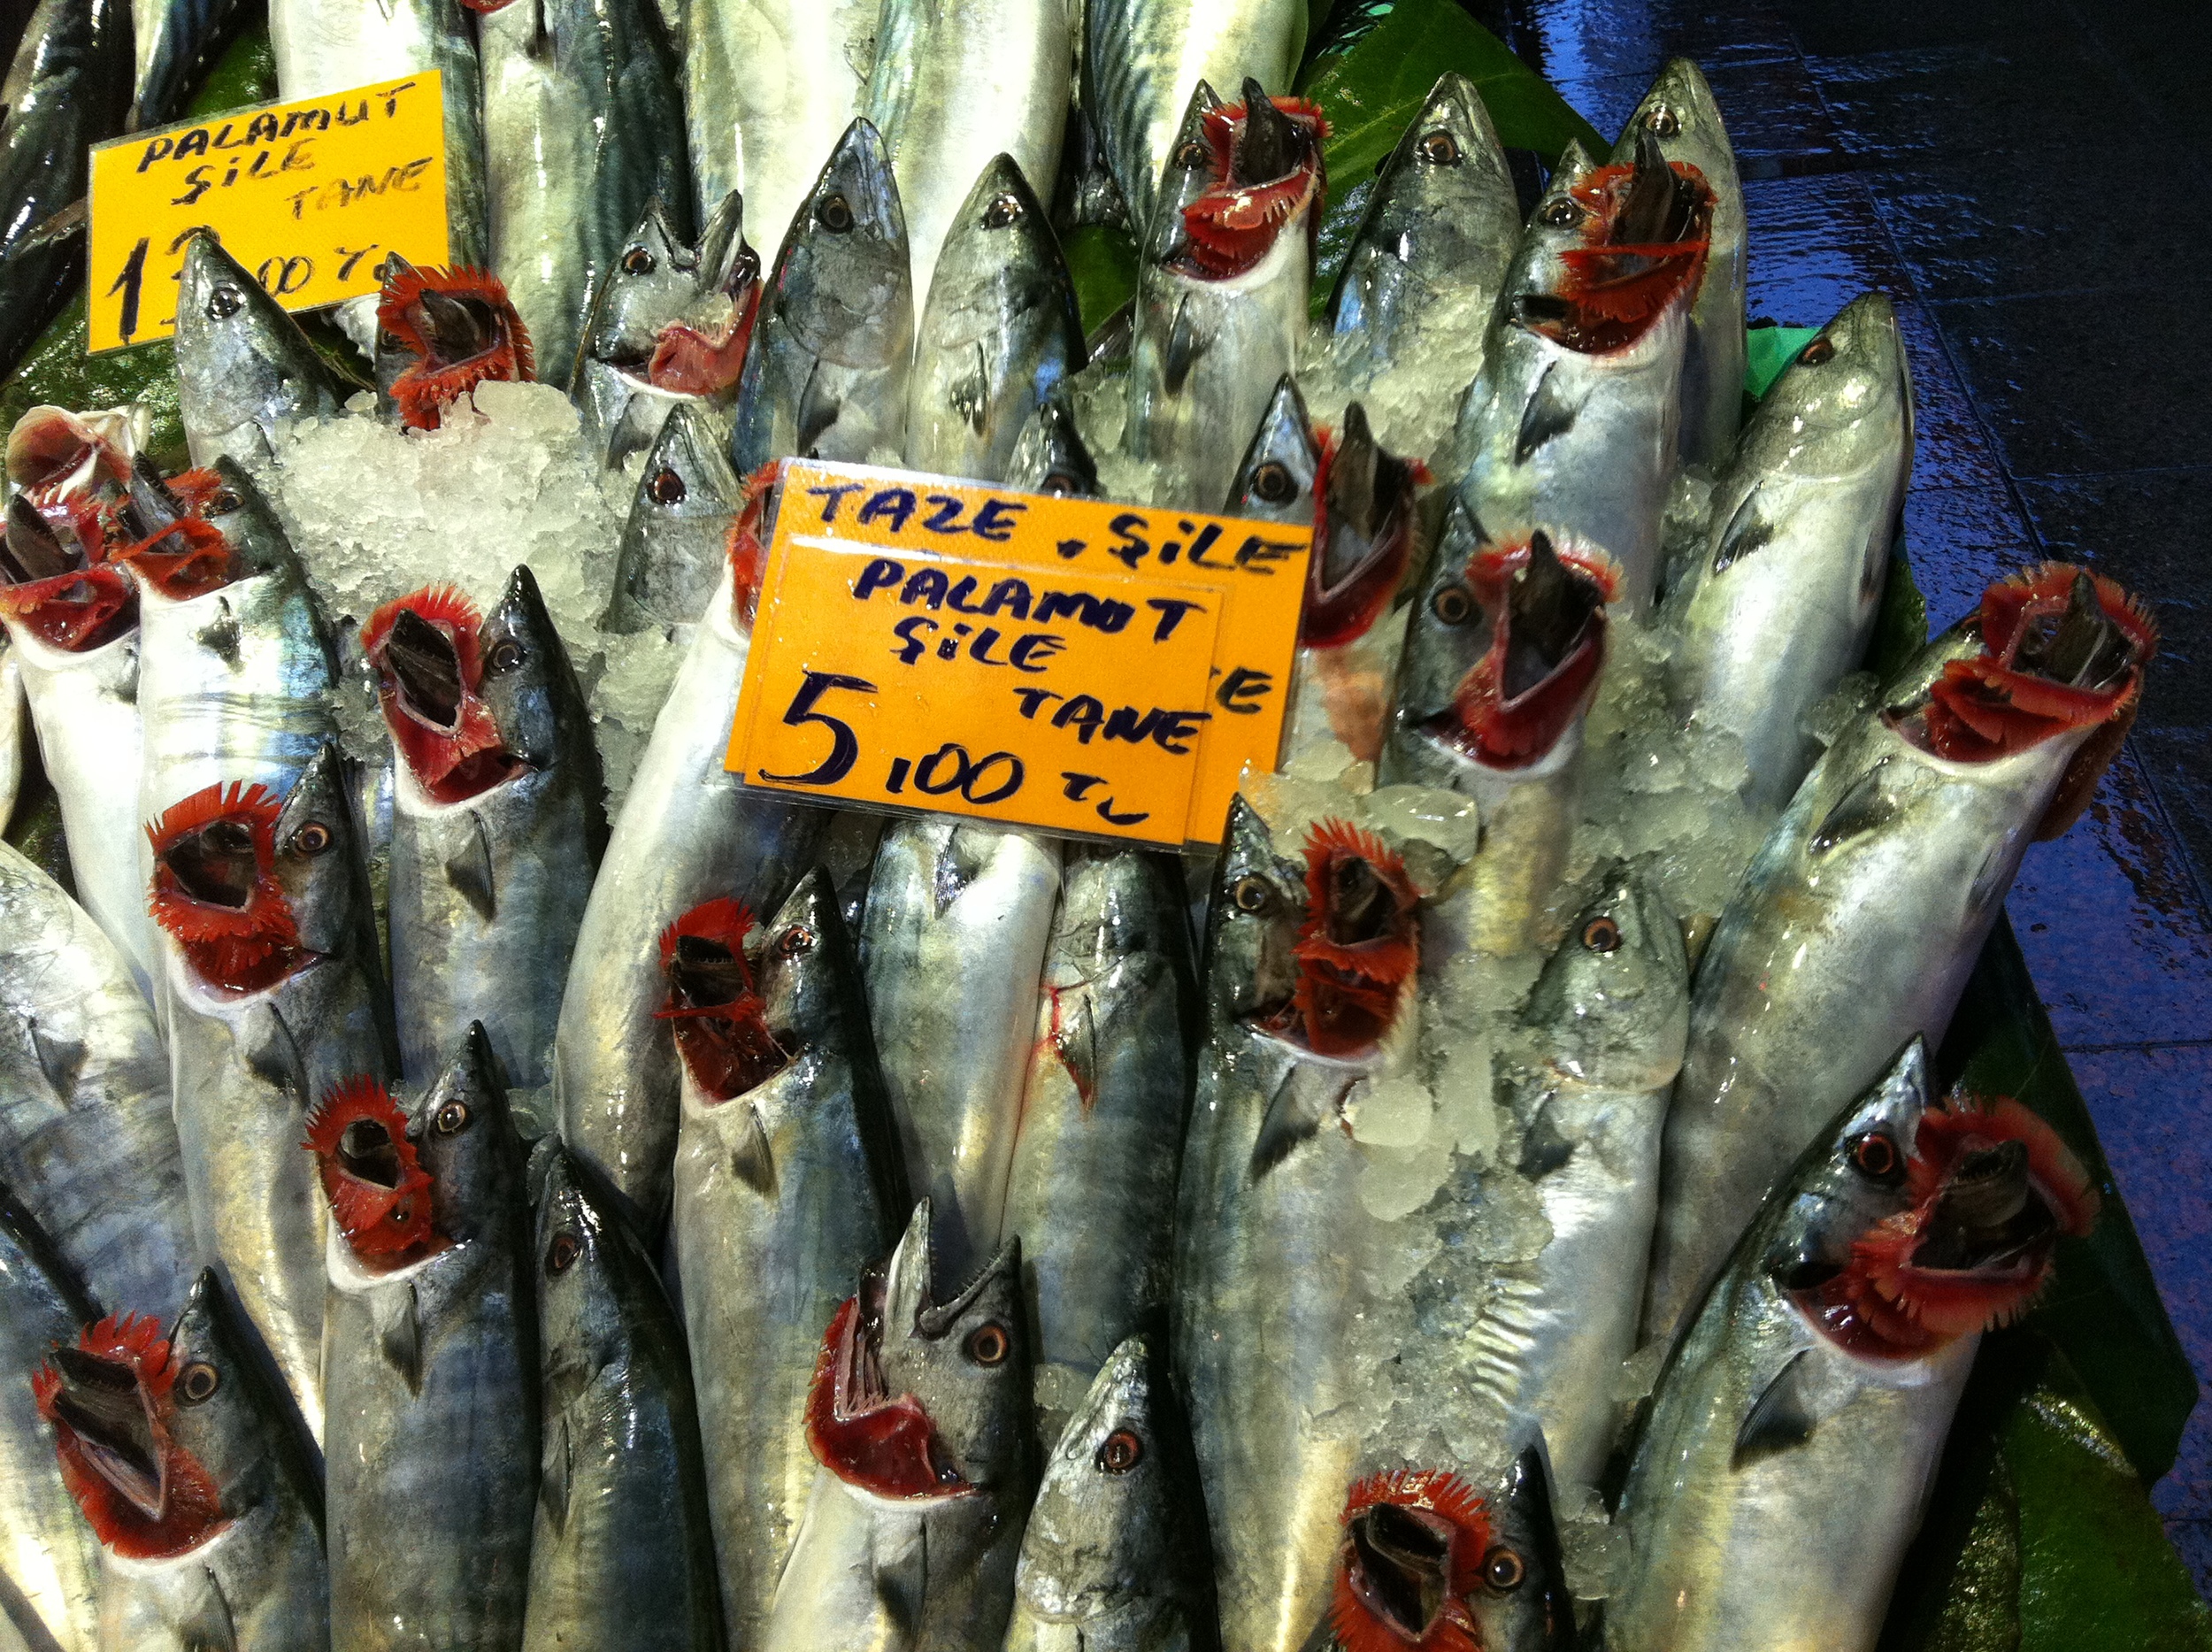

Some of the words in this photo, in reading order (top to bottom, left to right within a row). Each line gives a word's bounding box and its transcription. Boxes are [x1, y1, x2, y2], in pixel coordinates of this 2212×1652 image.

[135, 81, 417, 174] PALAMUT
[284, 156, 434, 220] TANE
[805, 482, 1029, 542] TAZE
[1013, 687, 1213, 756] TANE
